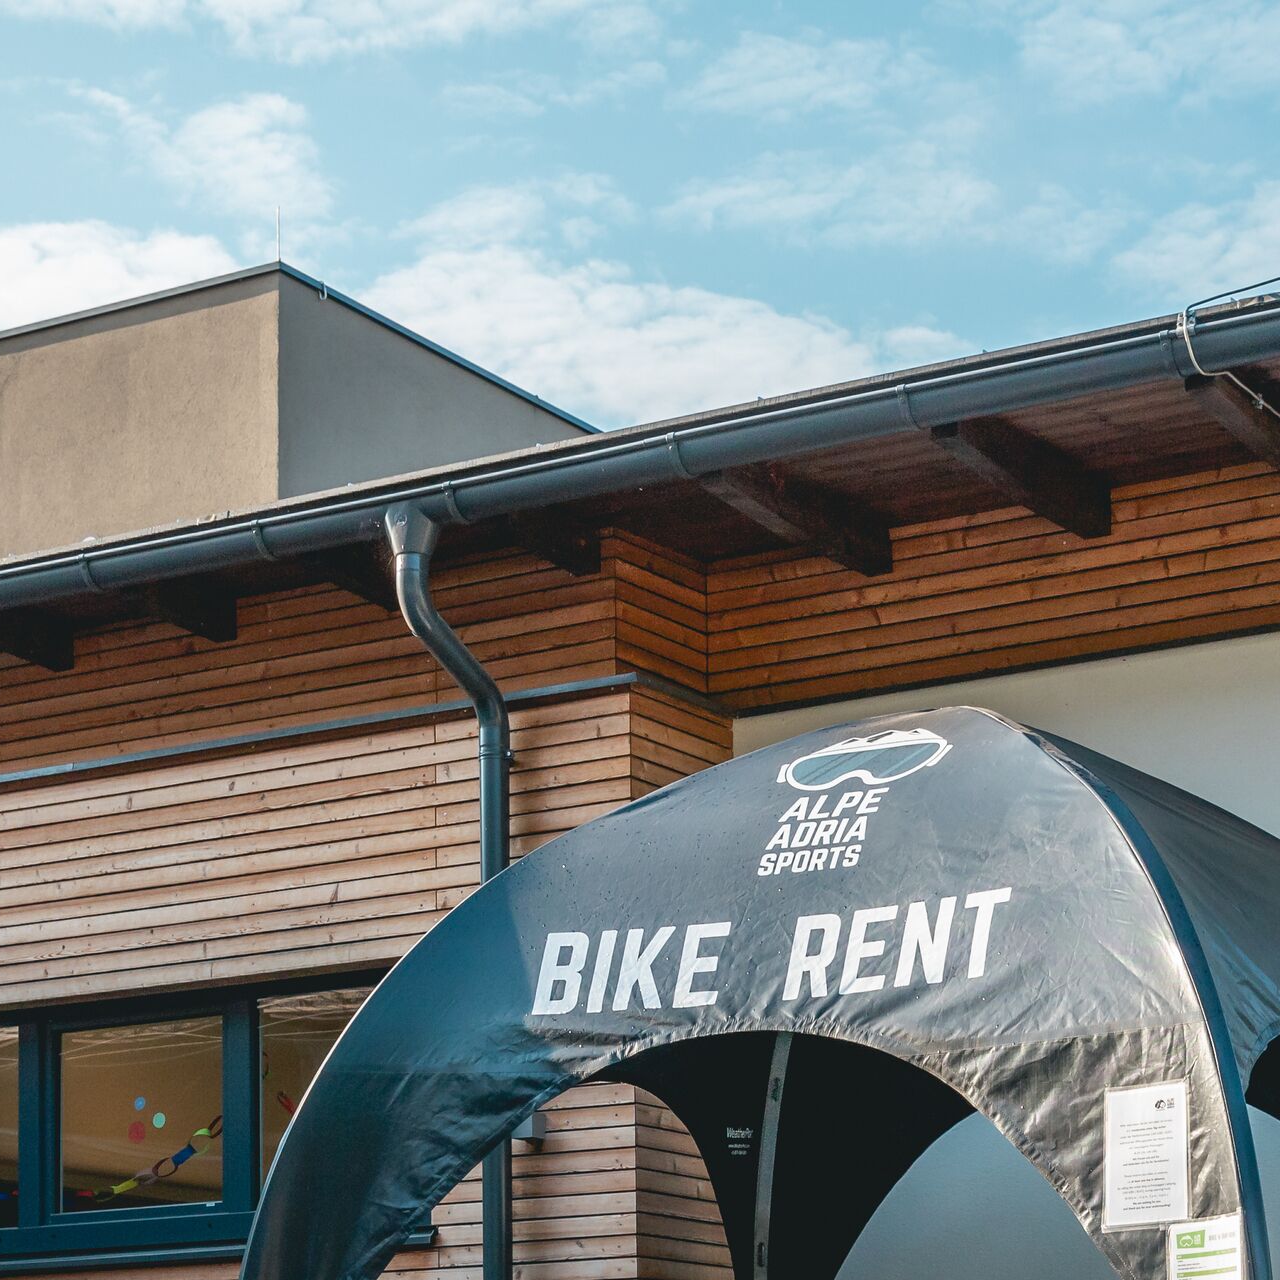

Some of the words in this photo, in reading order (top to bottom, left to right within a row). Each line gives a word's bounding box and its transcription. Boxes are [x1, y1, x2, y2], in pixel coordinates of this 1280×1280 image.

[778, 787, 890, 823] ALPE
[765, 816, 869, 850] ADRIA
[757, 845, 862, 877] SPORTS
[530, 921, 733, 1016] BIKE
[781, 886, 1013, 1001] RENT
